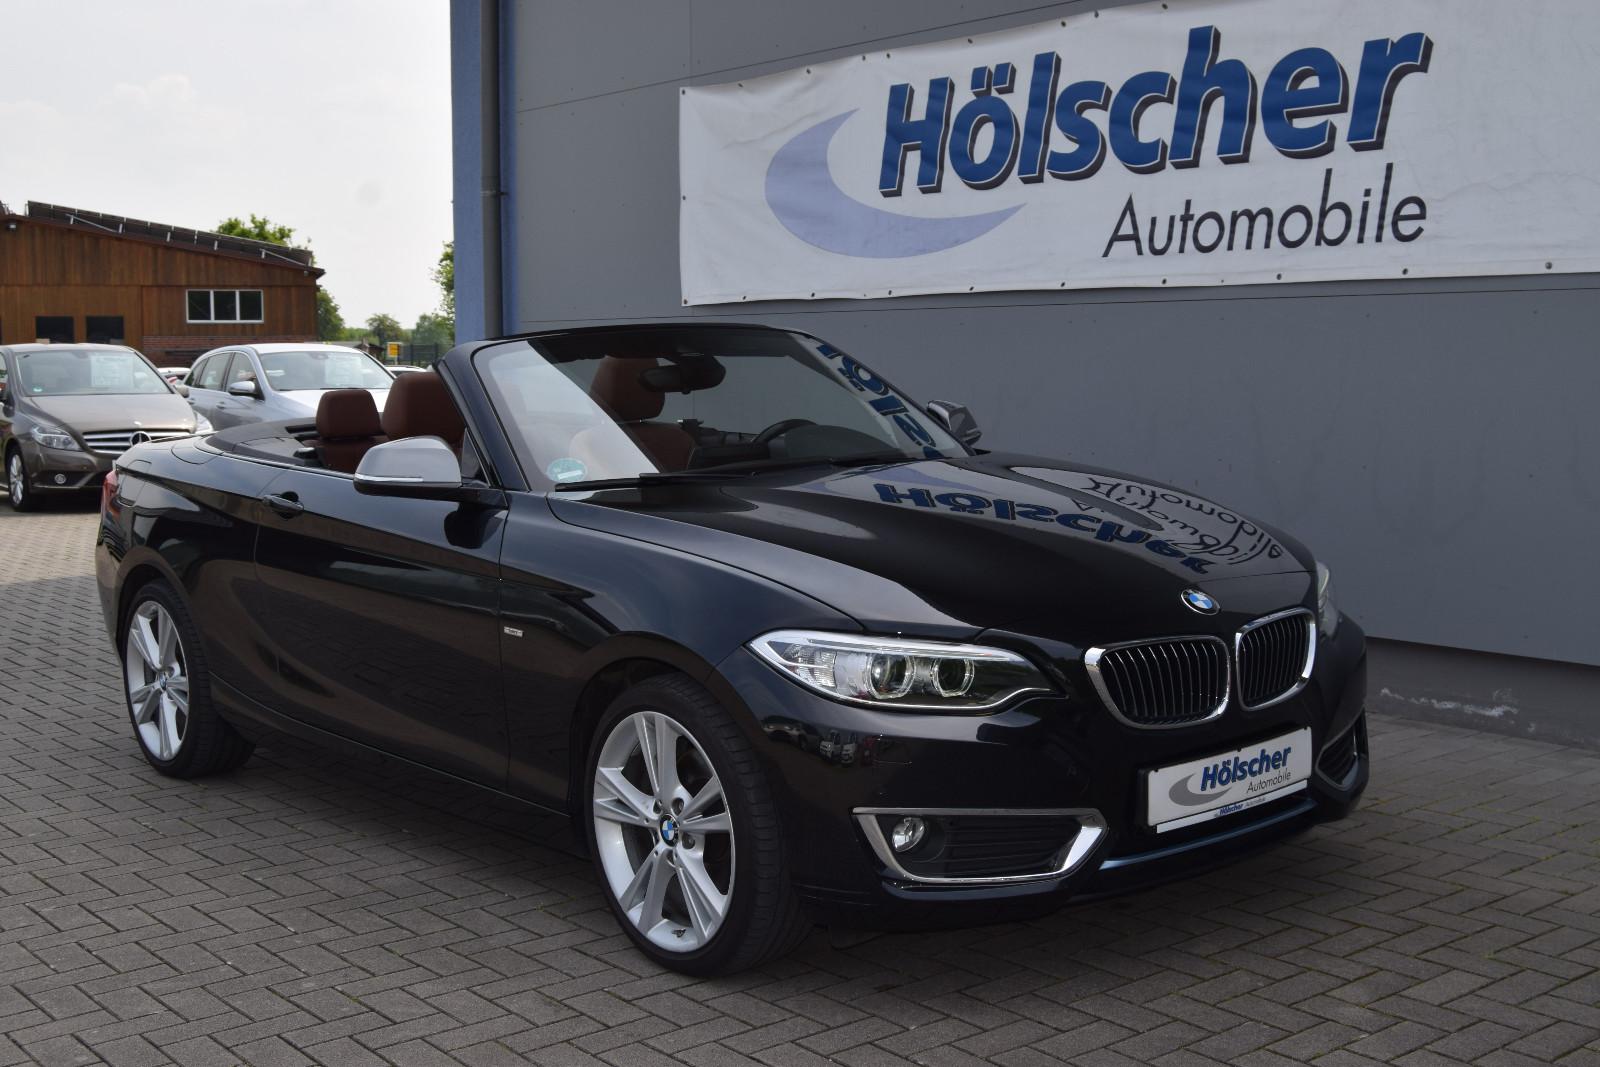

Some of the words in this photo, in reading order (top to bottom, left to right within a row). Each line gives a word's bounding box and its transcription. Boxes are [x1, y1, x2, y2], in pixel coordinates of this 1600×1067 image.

[879, 24, 1434, 198] Hölscher
[1102, 162, 1427, 258] Automobile
[1200, 746, 1292, 792] Hölscher
[1246, 767, 1292, 794] Automobile
